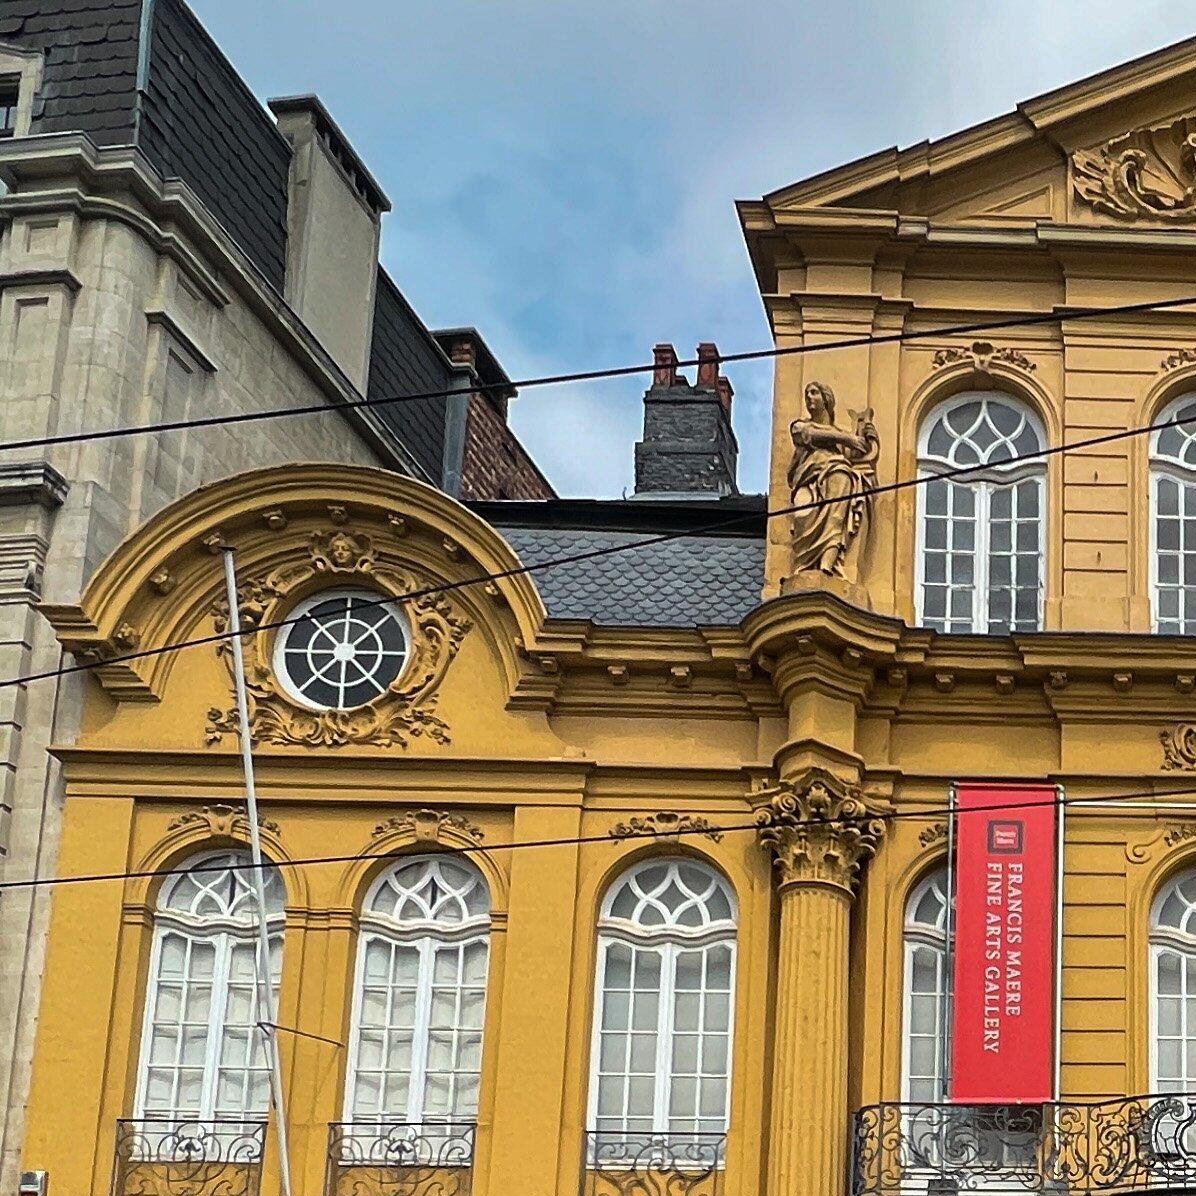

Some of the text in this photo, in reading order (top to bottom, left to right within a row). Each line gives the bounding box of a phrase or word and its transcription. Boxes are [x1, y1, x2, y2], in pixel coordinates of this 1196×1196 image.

[983, 862, 1003, 1053] FINE ARTS GALLERY
[1005, 862, 1023, 1016] FRANCIS MAERE
